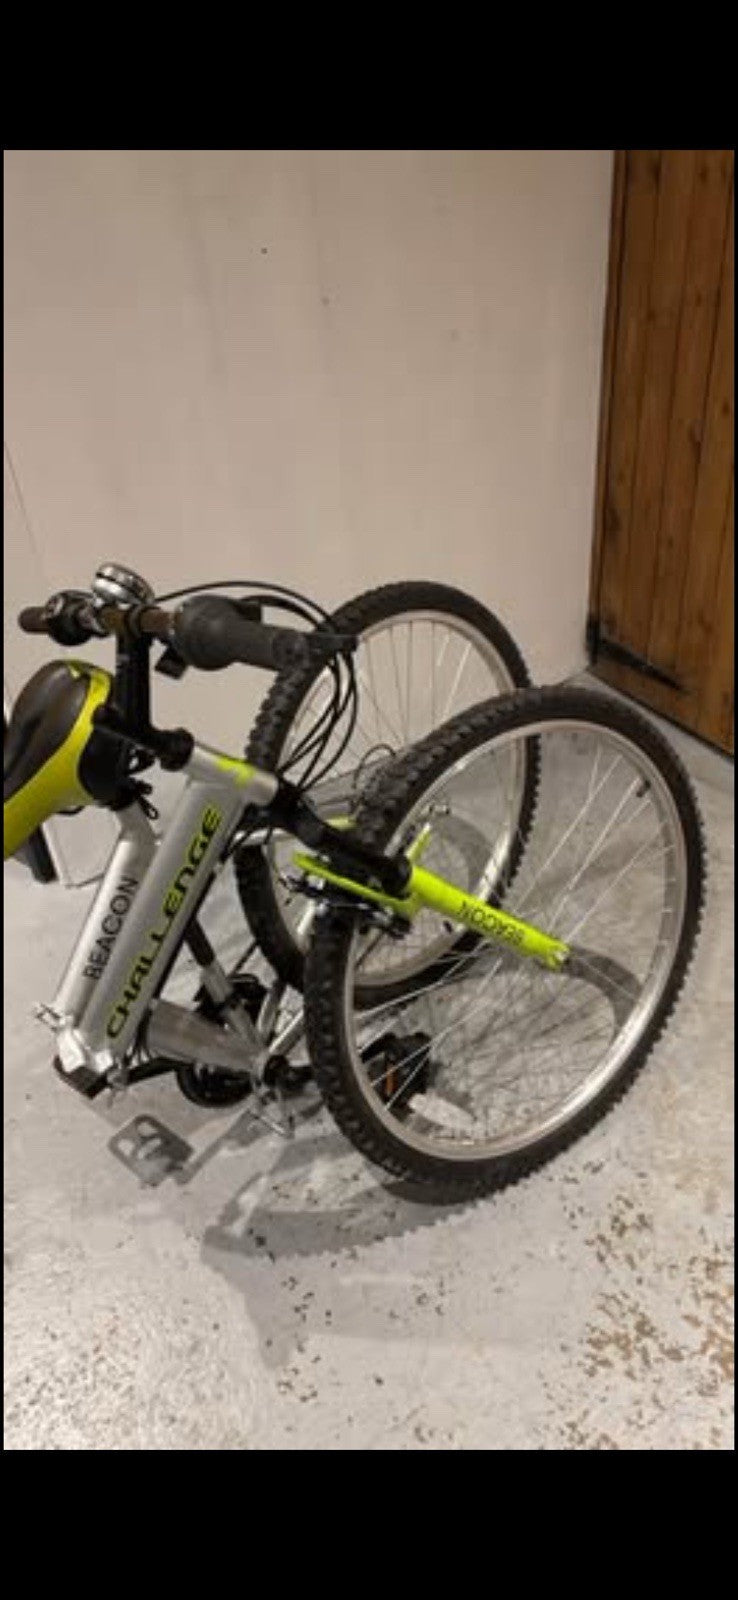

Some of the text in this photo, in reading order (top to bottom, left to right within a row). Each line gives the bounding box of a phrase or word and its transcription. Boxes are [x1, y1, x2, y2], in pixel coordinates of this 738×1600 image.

[83, 877, 138, 980] BEACON
[107, 807, 221, 1038] CHALLENGE
[457, 900, 524, 944] BEACON
